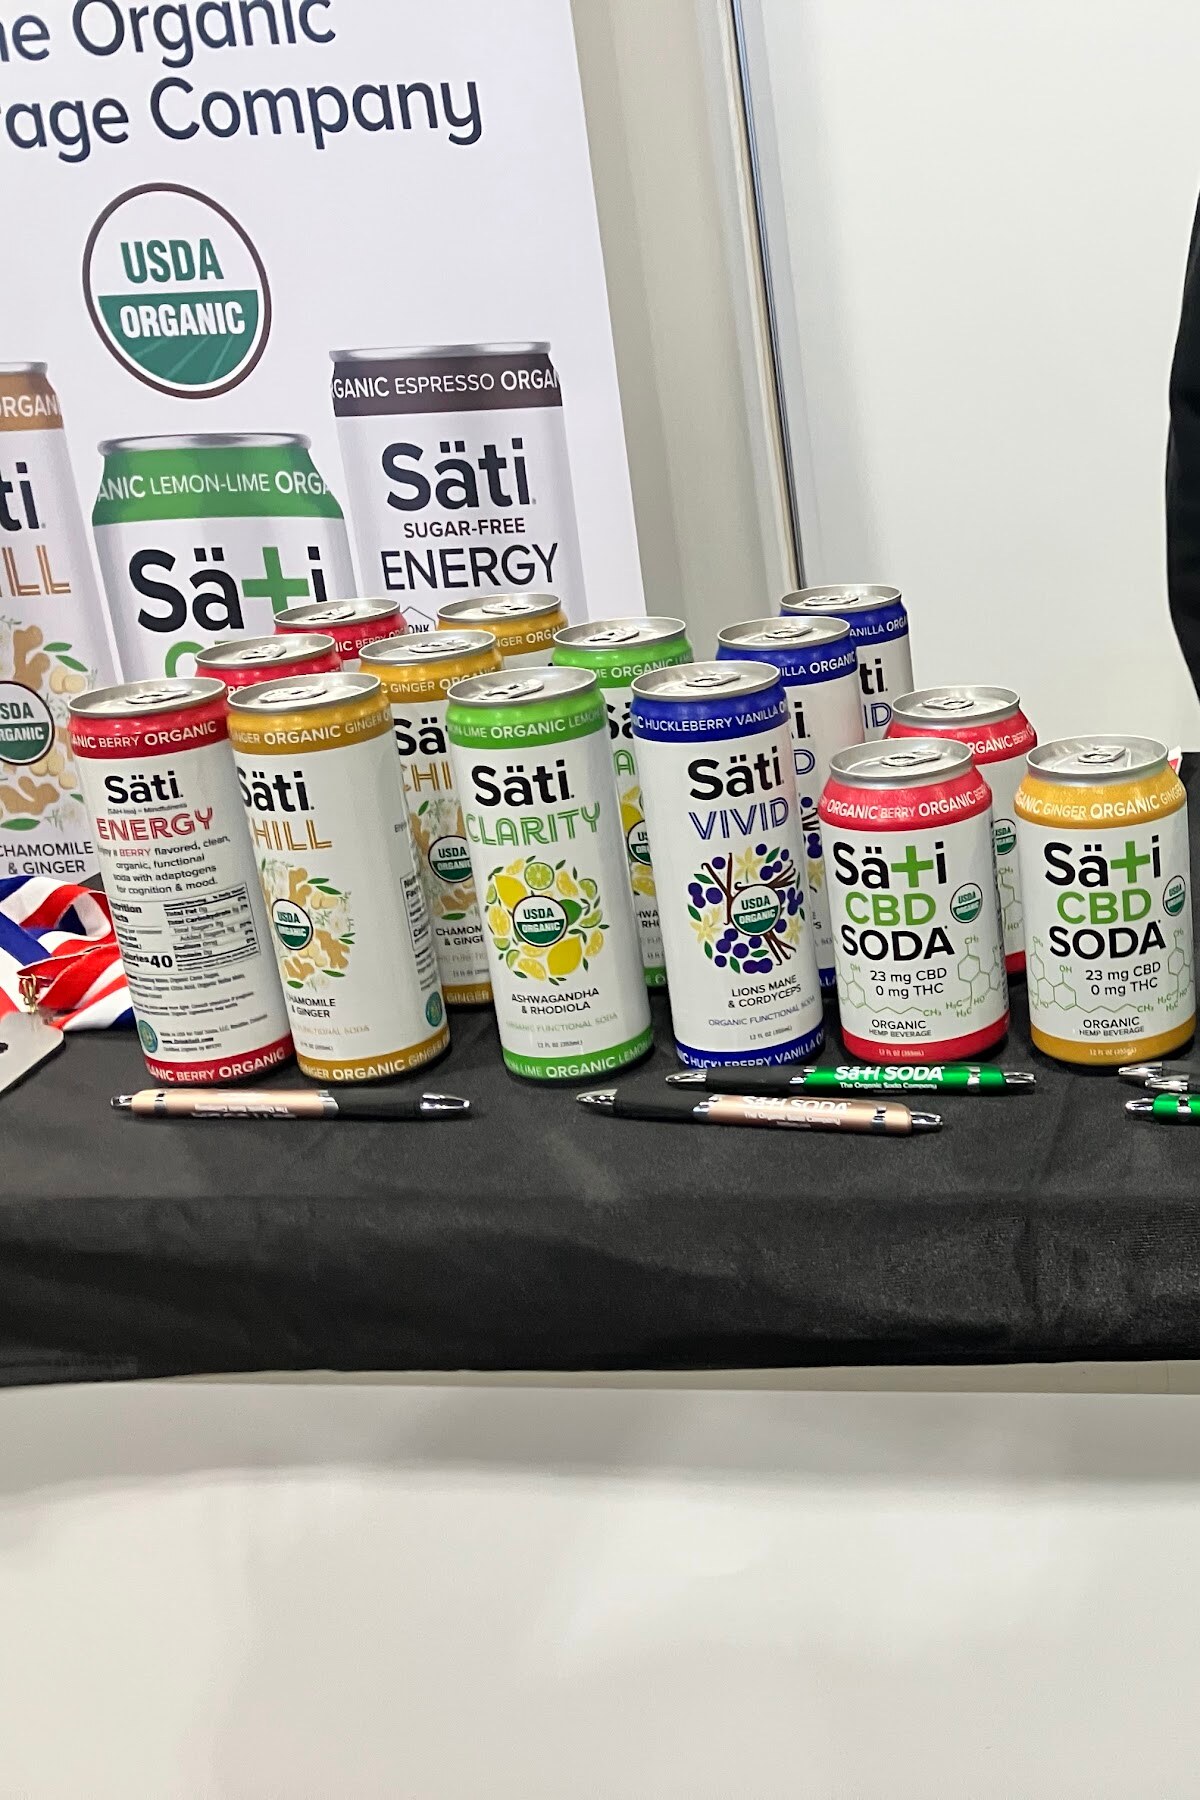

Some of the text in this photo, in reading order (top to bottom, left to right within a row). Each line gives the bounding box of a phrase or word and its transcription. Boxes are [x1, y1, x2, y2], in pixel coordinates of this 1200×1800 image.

[72, 0, 336, 68] Organic
[149, 76, 483, 149] Company
[119, 238, 224, 284] USDA
[119, 301, 245, 339] ORGANIC
[394, 374, 494, 394] ESPRESSO
[150, 473, 270, 496] LEMON-LIME
[403, 517, 526, 539] SUGAR-FREE
[381, 543, 558, 591] ENERGY
[391, 681, 435, 694] GINGER
[490, 719, 566, 739] ORGANIC
[645, 705, 778, 732] HUCKLEBERRY VANILLA
[99, 720, 217, 748] BERRY ORGANIC
[264, 726, 341, 744] ORGANIC
[827, 791, 975, 819] ORGANIC BERRY ORGANIC
[1043, 795, 1160, 819] GINGER ORGANIC
[96, 807, 214, 841] ENERGY
[465, 803, 600, 846] CLARITY
[689, 796, 789, 840] VIVID
[120, 835, 231, 857] BERRY flavored, clean,
[8, 860, 86, 875] & GINGER
[116, 854, 205, 870] organic, functional
[134, 865, 217, 882] with adaptogens
[129, 878, 218, 896] cognition & mood.
[523, 908, 554, 920] USDA
[741, 896, 771, 910] USDA
[845, 892, 936, 926] CBD
[1057, 889, 1152, 924] CBD
[521, 921, 561, 933] ORGANIC
[739, 910, 776, 924] ORGANIC
[841, 925, 955, 961] SODA
[1049, 921, 1166, 960] SODA
[150, 955, 173, 968] 40
[1085, 961, 1161, 981] 23 mg CBD
[731, 975, 797, 997] LIONS MANE
[870, 967, 947, 984] 23 mg CBD
[511, 988, 599, 1004] ASHWAGANDHA
[728, 984, 801, 1008] & CORDYCEPS
[521, 1002, 591, 1015] & RHODIOLA
[872, 1019, 926, 1029] ORGANIC
[1083, 1017, 1140, 1028] ORGANIC
[855, 1082, 883, 1090] Organic
[903, 1082, 938, 1090] Company
